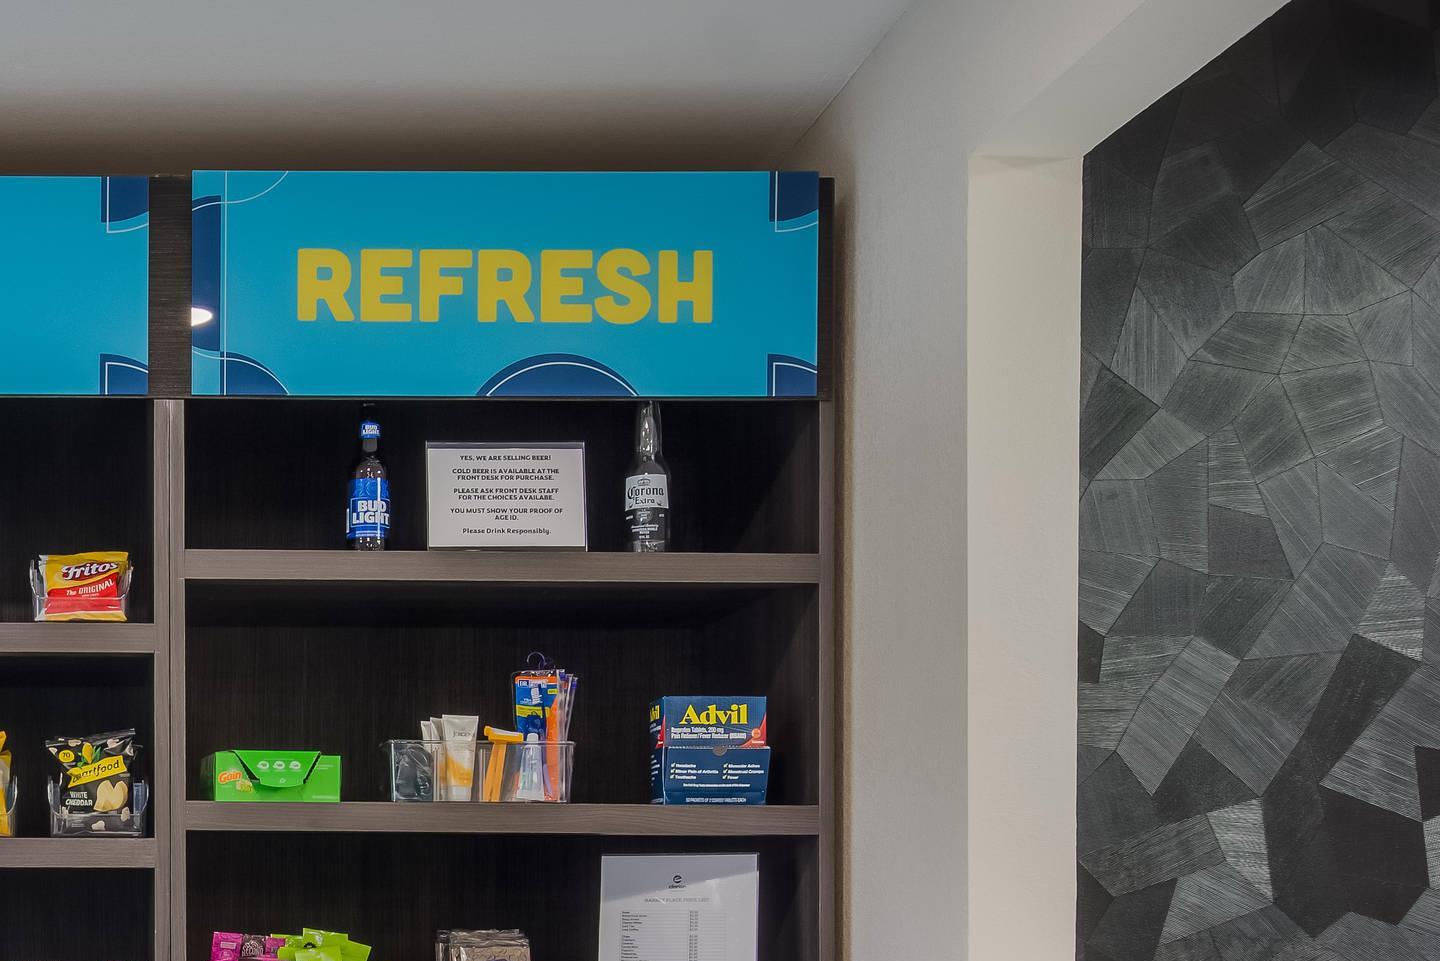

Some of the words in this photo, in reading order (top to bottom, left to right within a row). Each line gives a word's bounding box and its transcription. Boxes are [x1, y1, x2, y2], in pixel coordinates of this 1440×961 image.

[297, 248, 714, 324] REFRESH
[627, 486, 664, 499] Corona
[357, 500, 387, 512] BUD
[352, 512, 390, 525] LIGHT
[61, 562, 119, 580] Fritos
[78, 579, 115, 594] ORIGINAL
[678, 703, 749, 725] Advil
[71, 759, 120, 784] artfood
